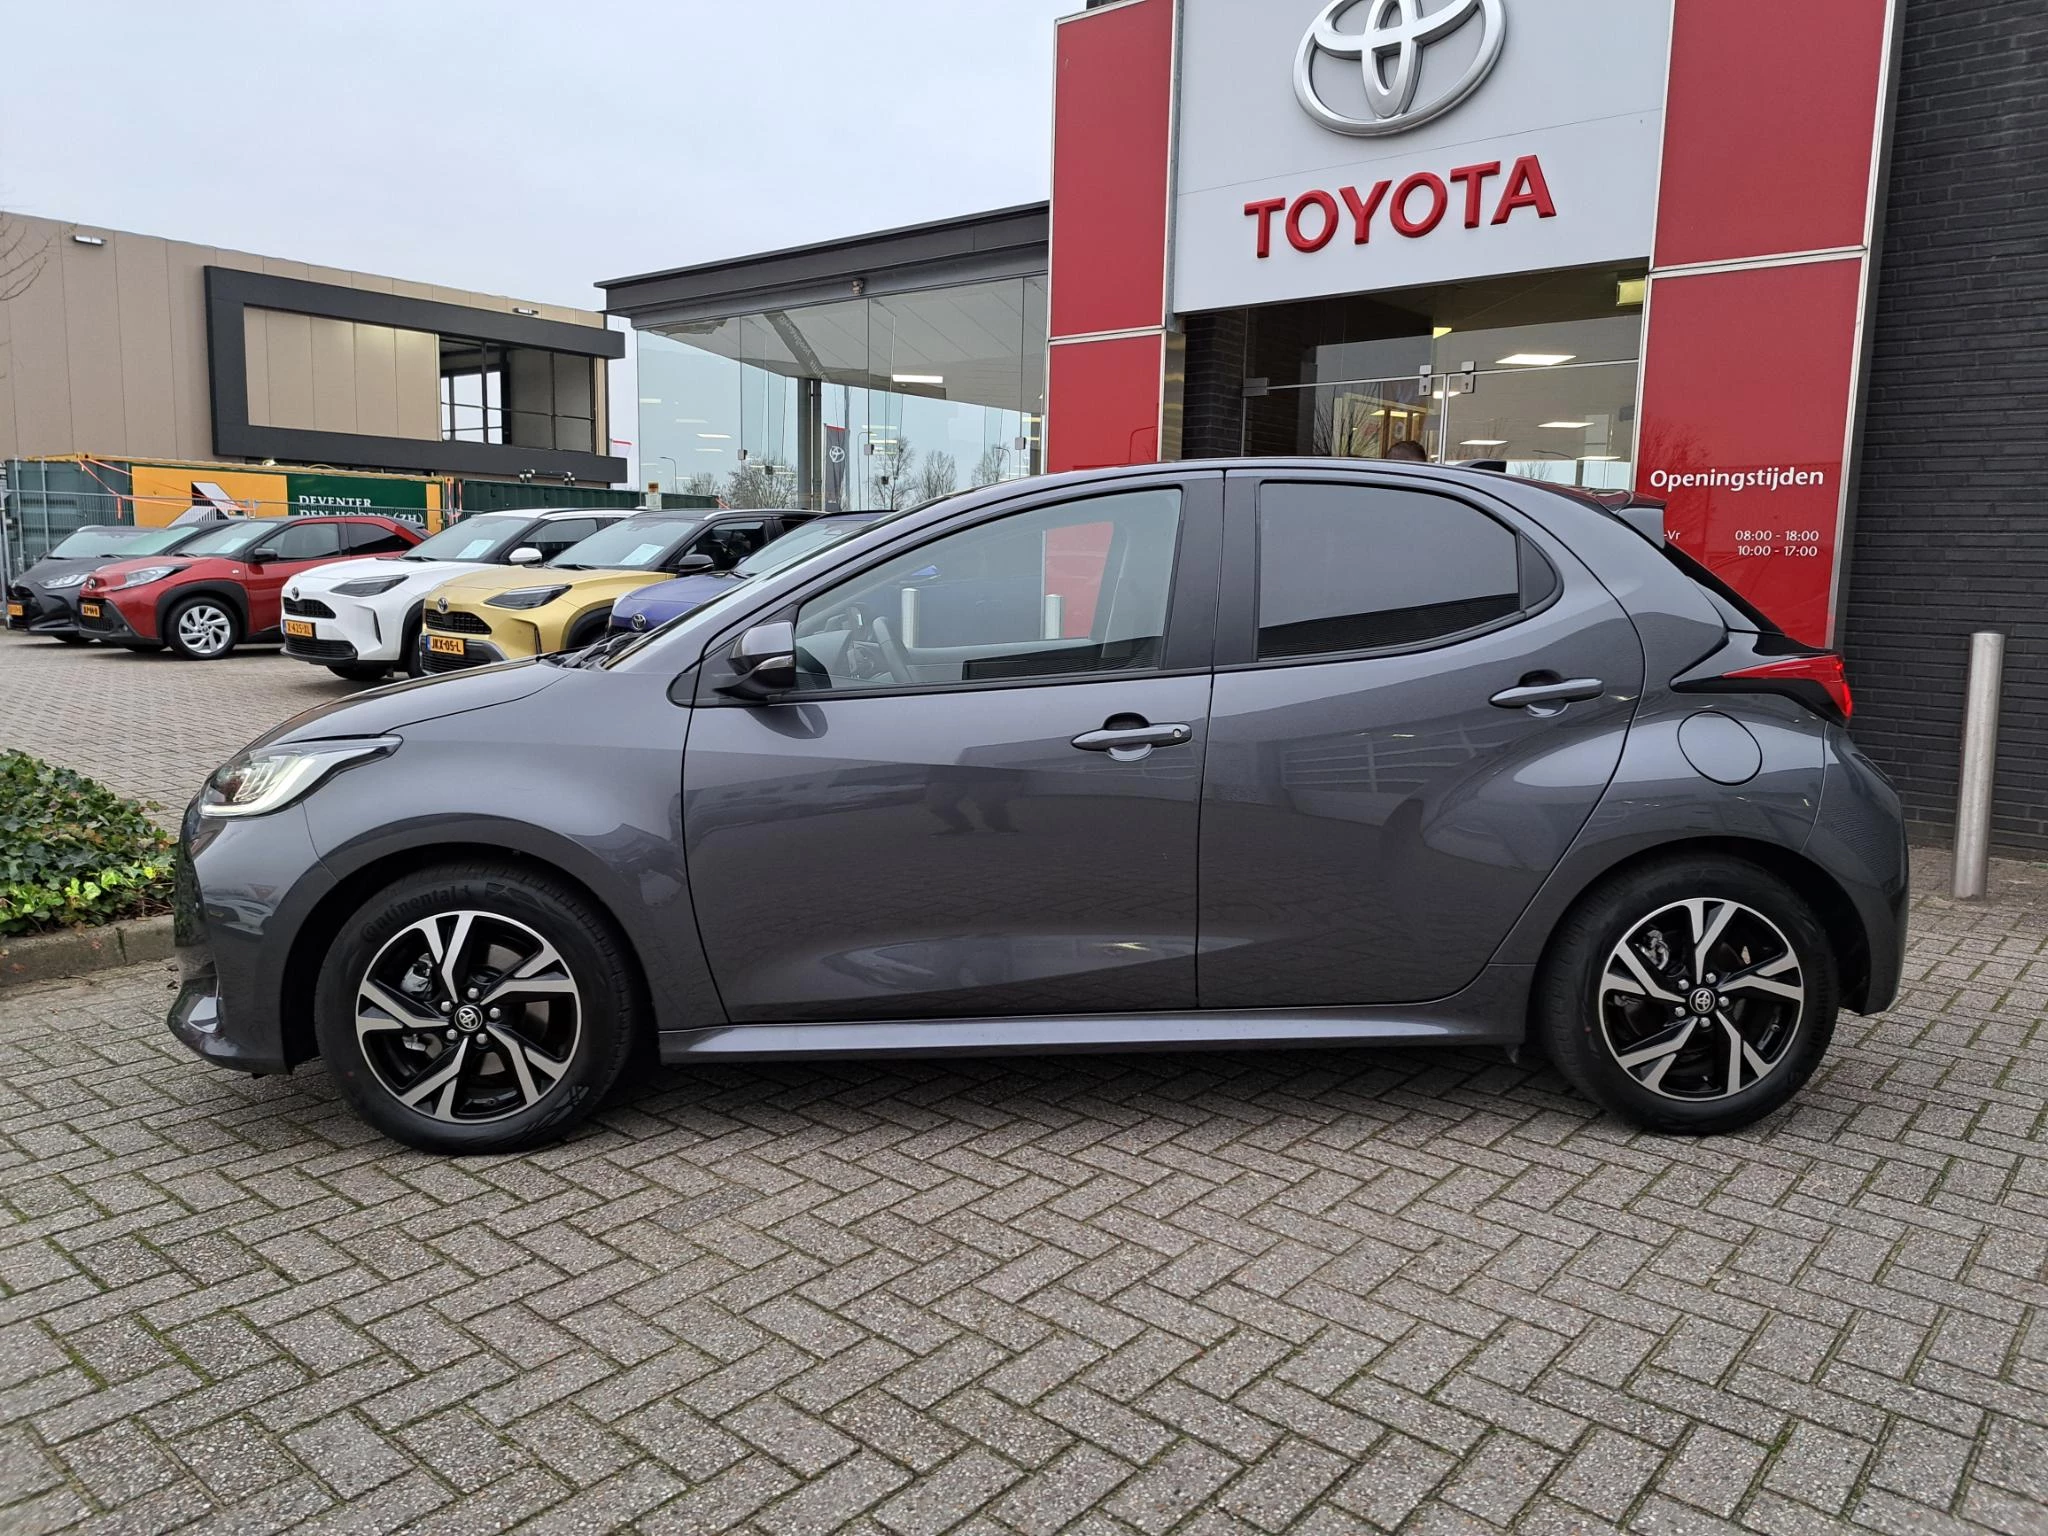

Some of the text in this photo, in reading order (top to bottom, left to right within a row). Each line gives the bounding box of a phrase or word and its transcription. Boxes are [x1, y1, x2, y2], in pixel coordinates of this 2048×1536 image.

[1244, 154, 1557, 258] TOYOTA
[1650, 466, 1824, 492] Openingstijden
[298, 495, 372, 507] DEVENTER
[1735, 530, 1772, 541] 08:00
[1785, 530, 1819, 542] 18:00
[1737, 545, 1771, 557] 10:00
[1784, 545, 1818, 557] 17:00
[431, 637, 462, 653] JKX-05-L
